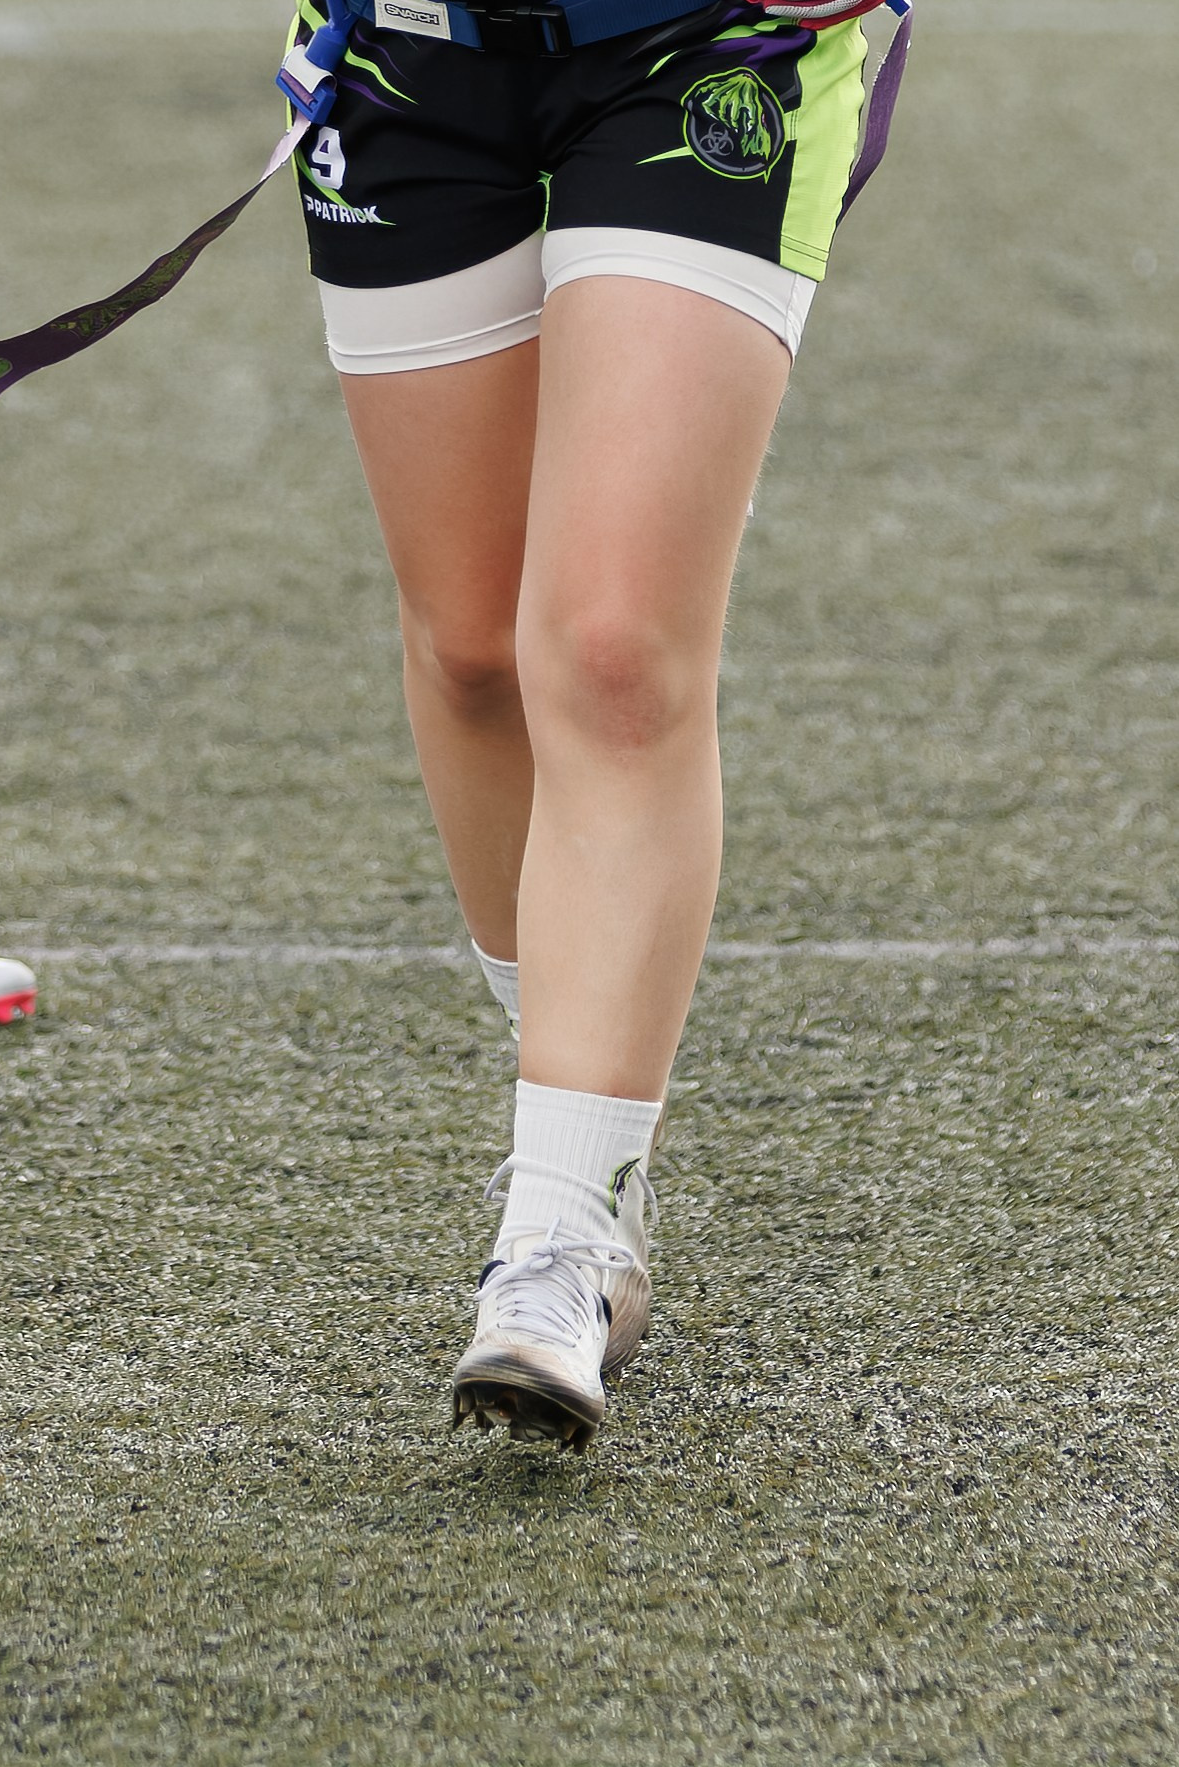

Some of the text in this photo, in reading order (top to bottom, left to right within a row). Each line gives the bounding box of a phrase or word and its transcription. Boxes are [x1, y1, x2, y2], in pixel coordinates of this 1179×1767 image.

[384, 3, 440, 25] SNATCH
[311, 126, 346, 190] 9
[314, 198, 382, 223] PATRICK
